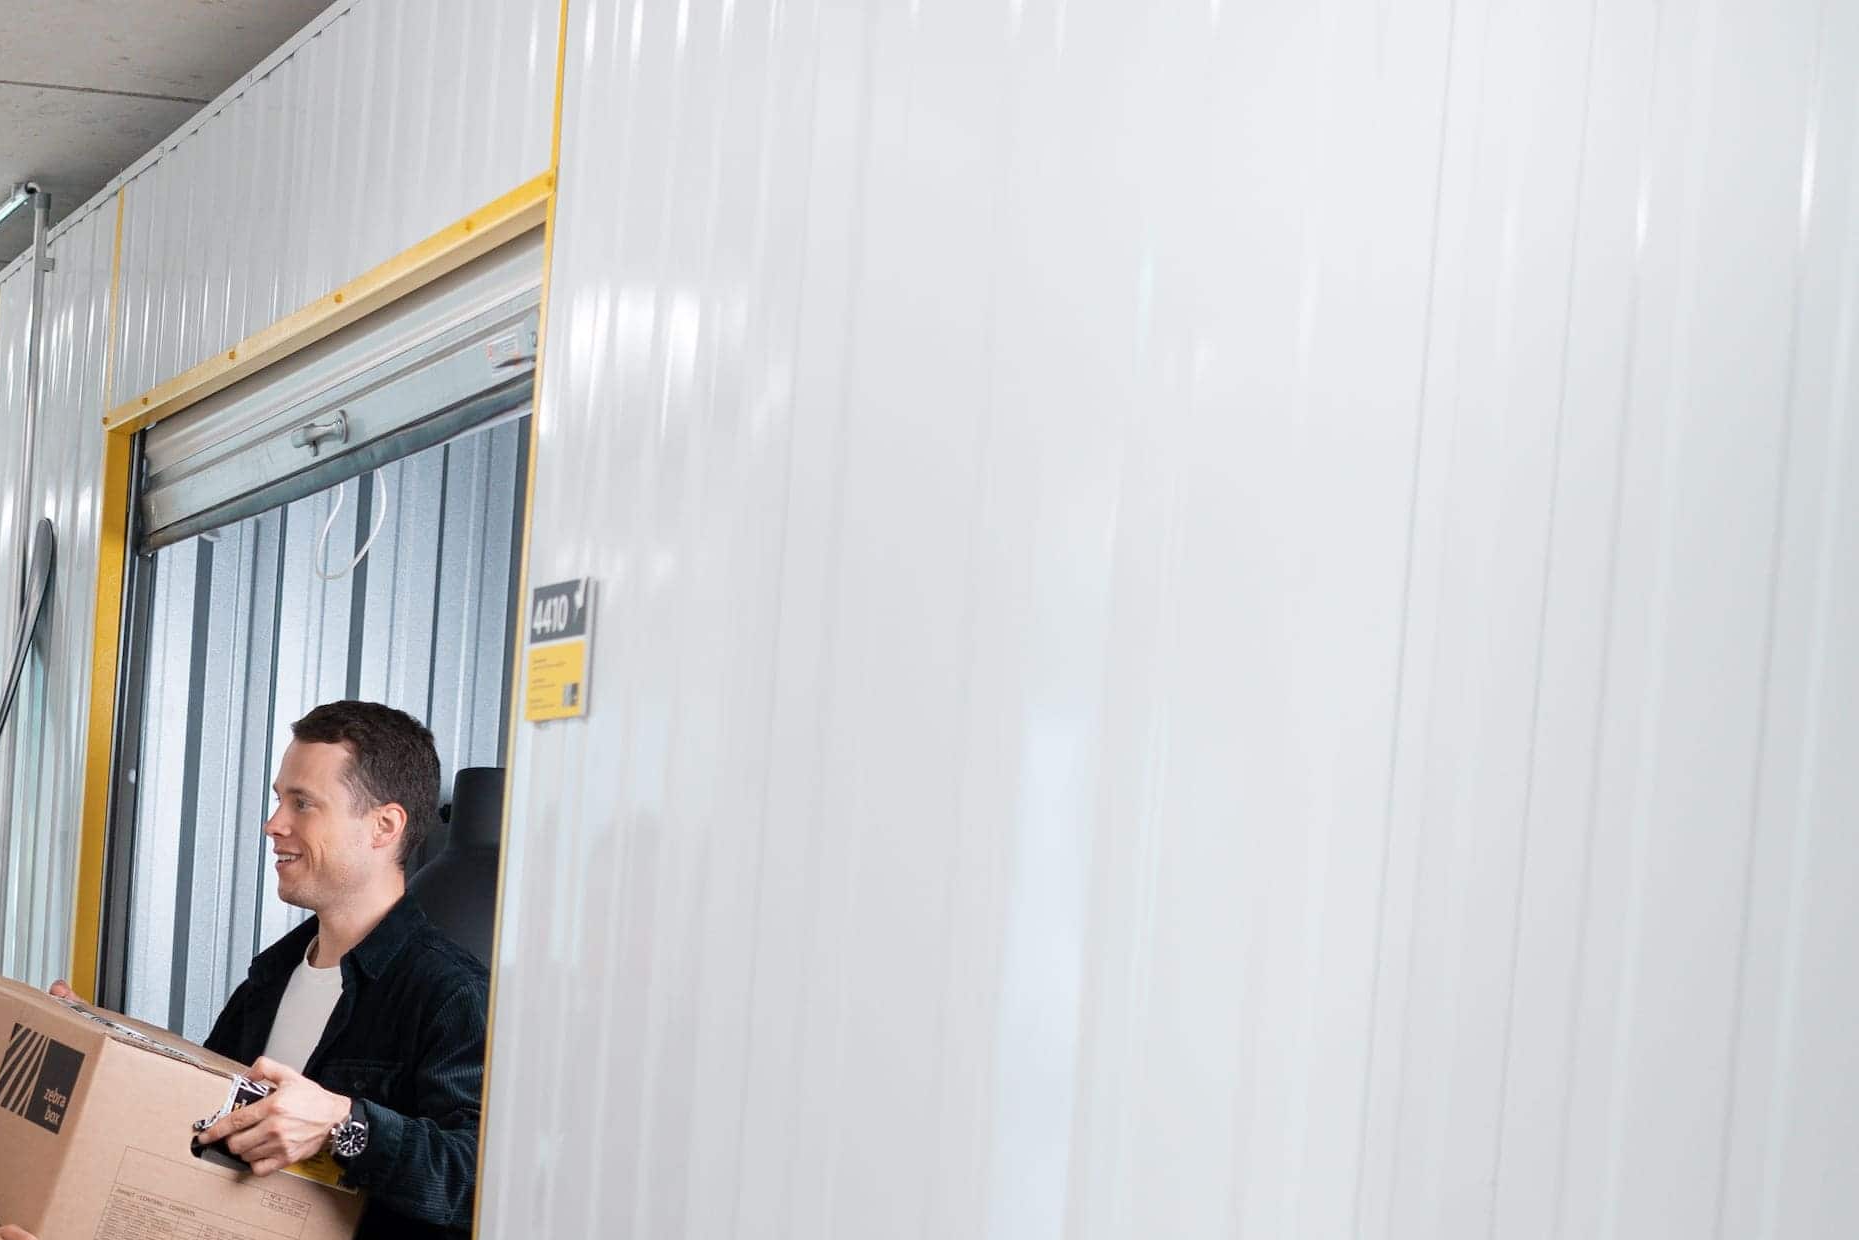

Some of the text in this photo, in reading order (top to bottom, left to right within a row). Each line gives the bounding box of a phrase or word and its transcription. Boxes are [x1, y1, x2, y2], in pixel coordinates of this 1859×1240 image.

[531, 594, 569, 635] 4410
[43, 1088, 67, 1107] zebra
[44, 1104, 60, 1125] box
